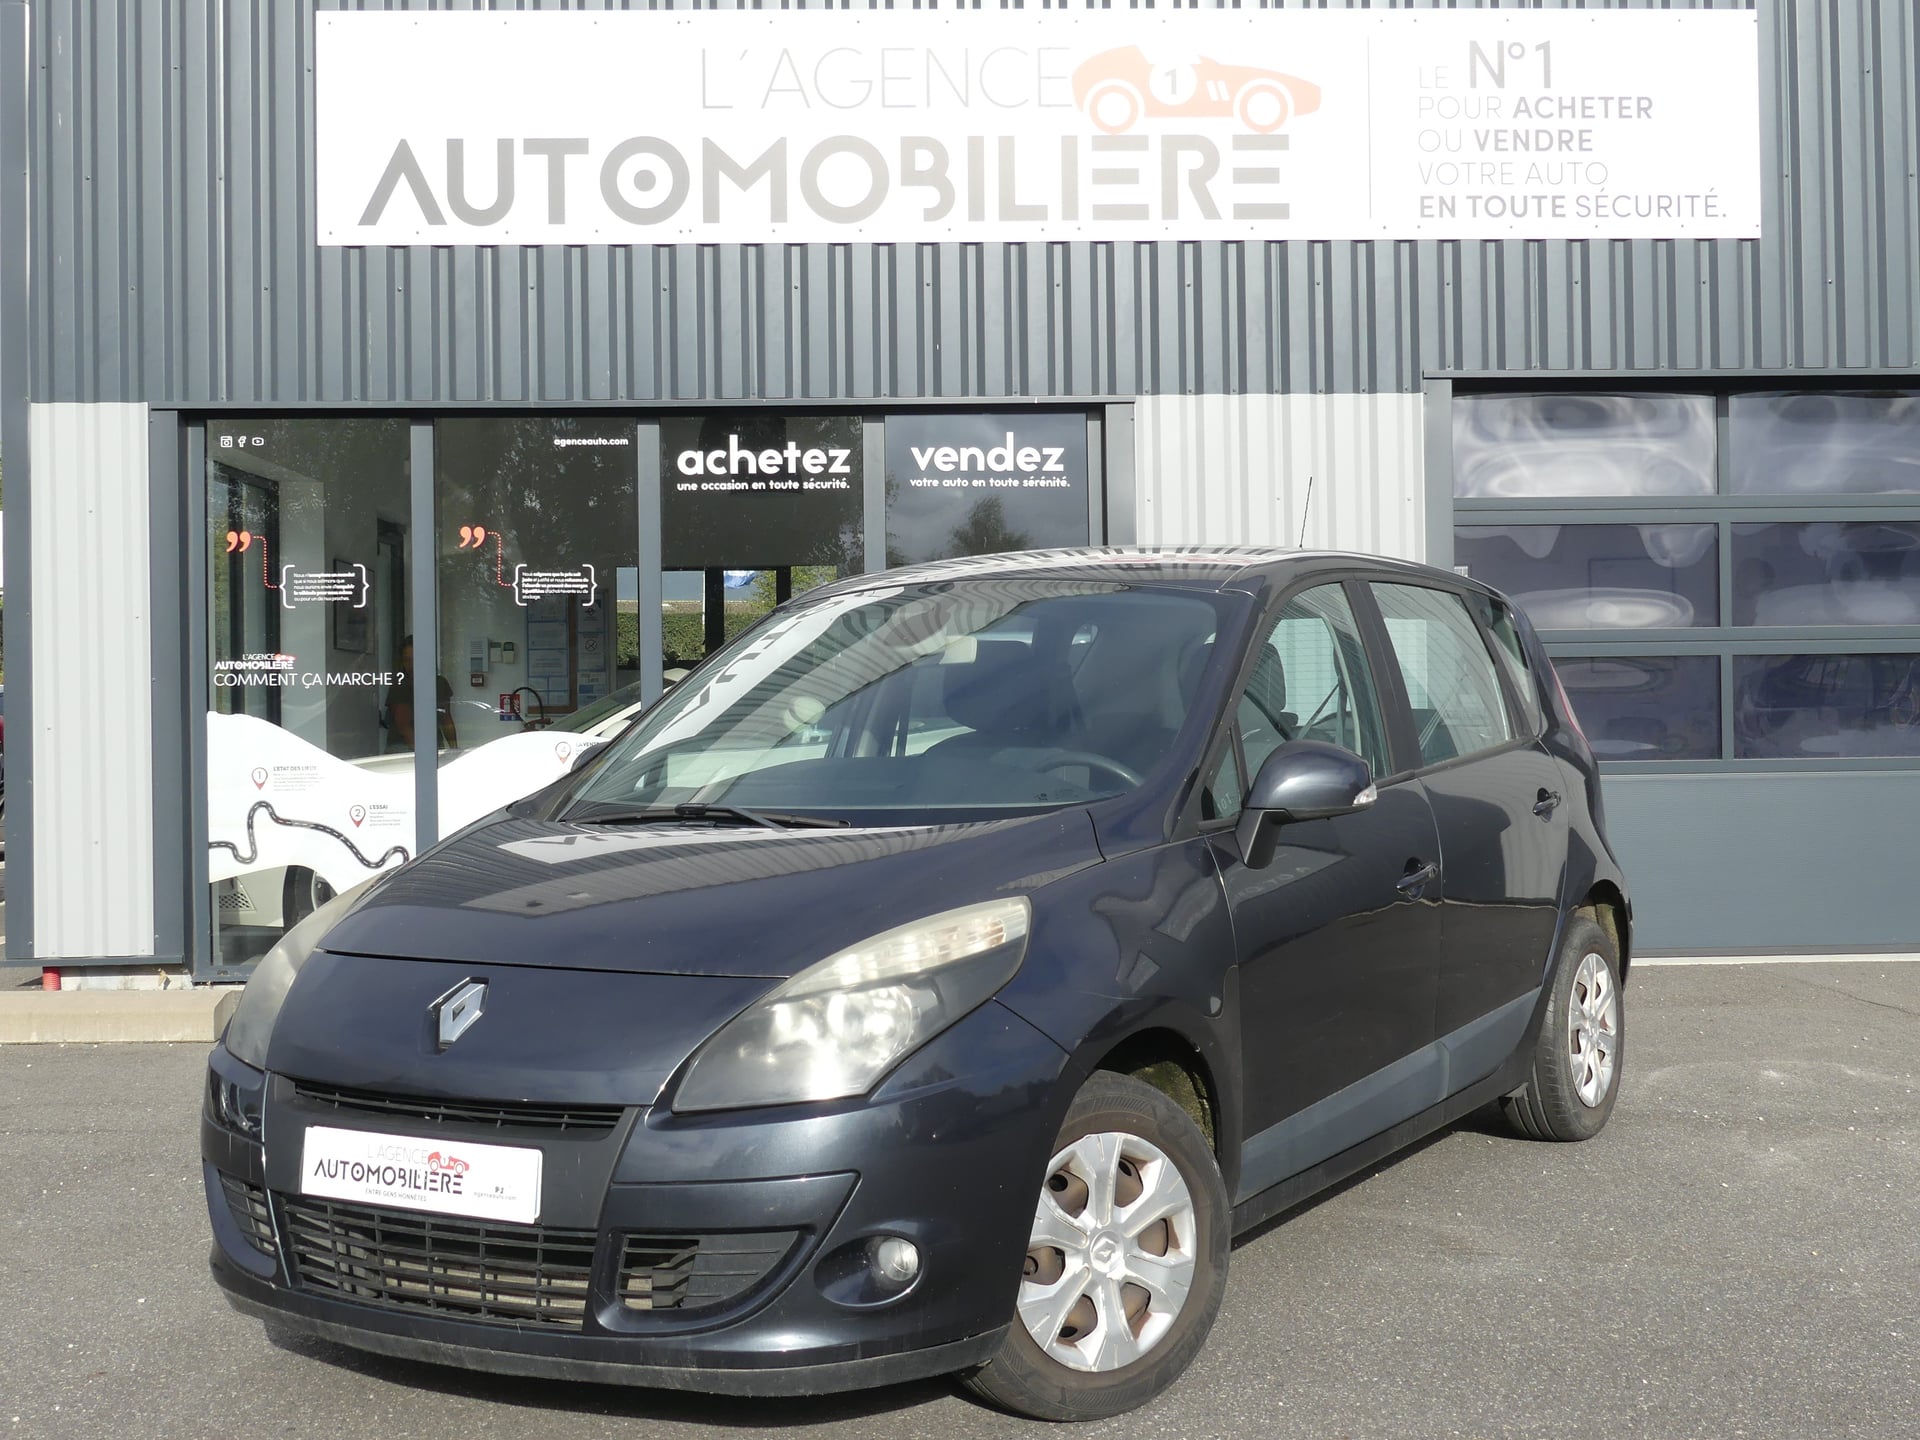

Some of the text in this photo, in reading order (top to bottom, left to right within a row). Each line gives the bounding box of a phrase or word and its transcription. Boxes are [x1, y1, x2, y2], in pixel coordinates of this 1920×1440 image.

[702, 46, 1072, 110] L'AGENCE
[1418, 65, 1449, 90] LE
[1418, 95, 1654, 121] POUR ACHETER
[1418, 127, 1594, 154] OU VENDRE
[1418, 160, 1610, 188] VOTRE AUTO
[1419, 186, 1729, 219] EN TOUTE SÉCURITÉ.
[553, 437, 630, 448] agenceauto.com
[676, 434, 851, 476] achetez
[910, 431, 1065, 472] vendez
[676, 477, 850, 491] une occasion en toute sécurité.
[909, 475, 1071, 488] votre auto en toute sérénité.
[242, 653, 276, 661] L'AGENCE
[213, 672, 405, 689] COMMENT ÇA MARCHE ?
[382, 1190, 397, 1198] GENS
